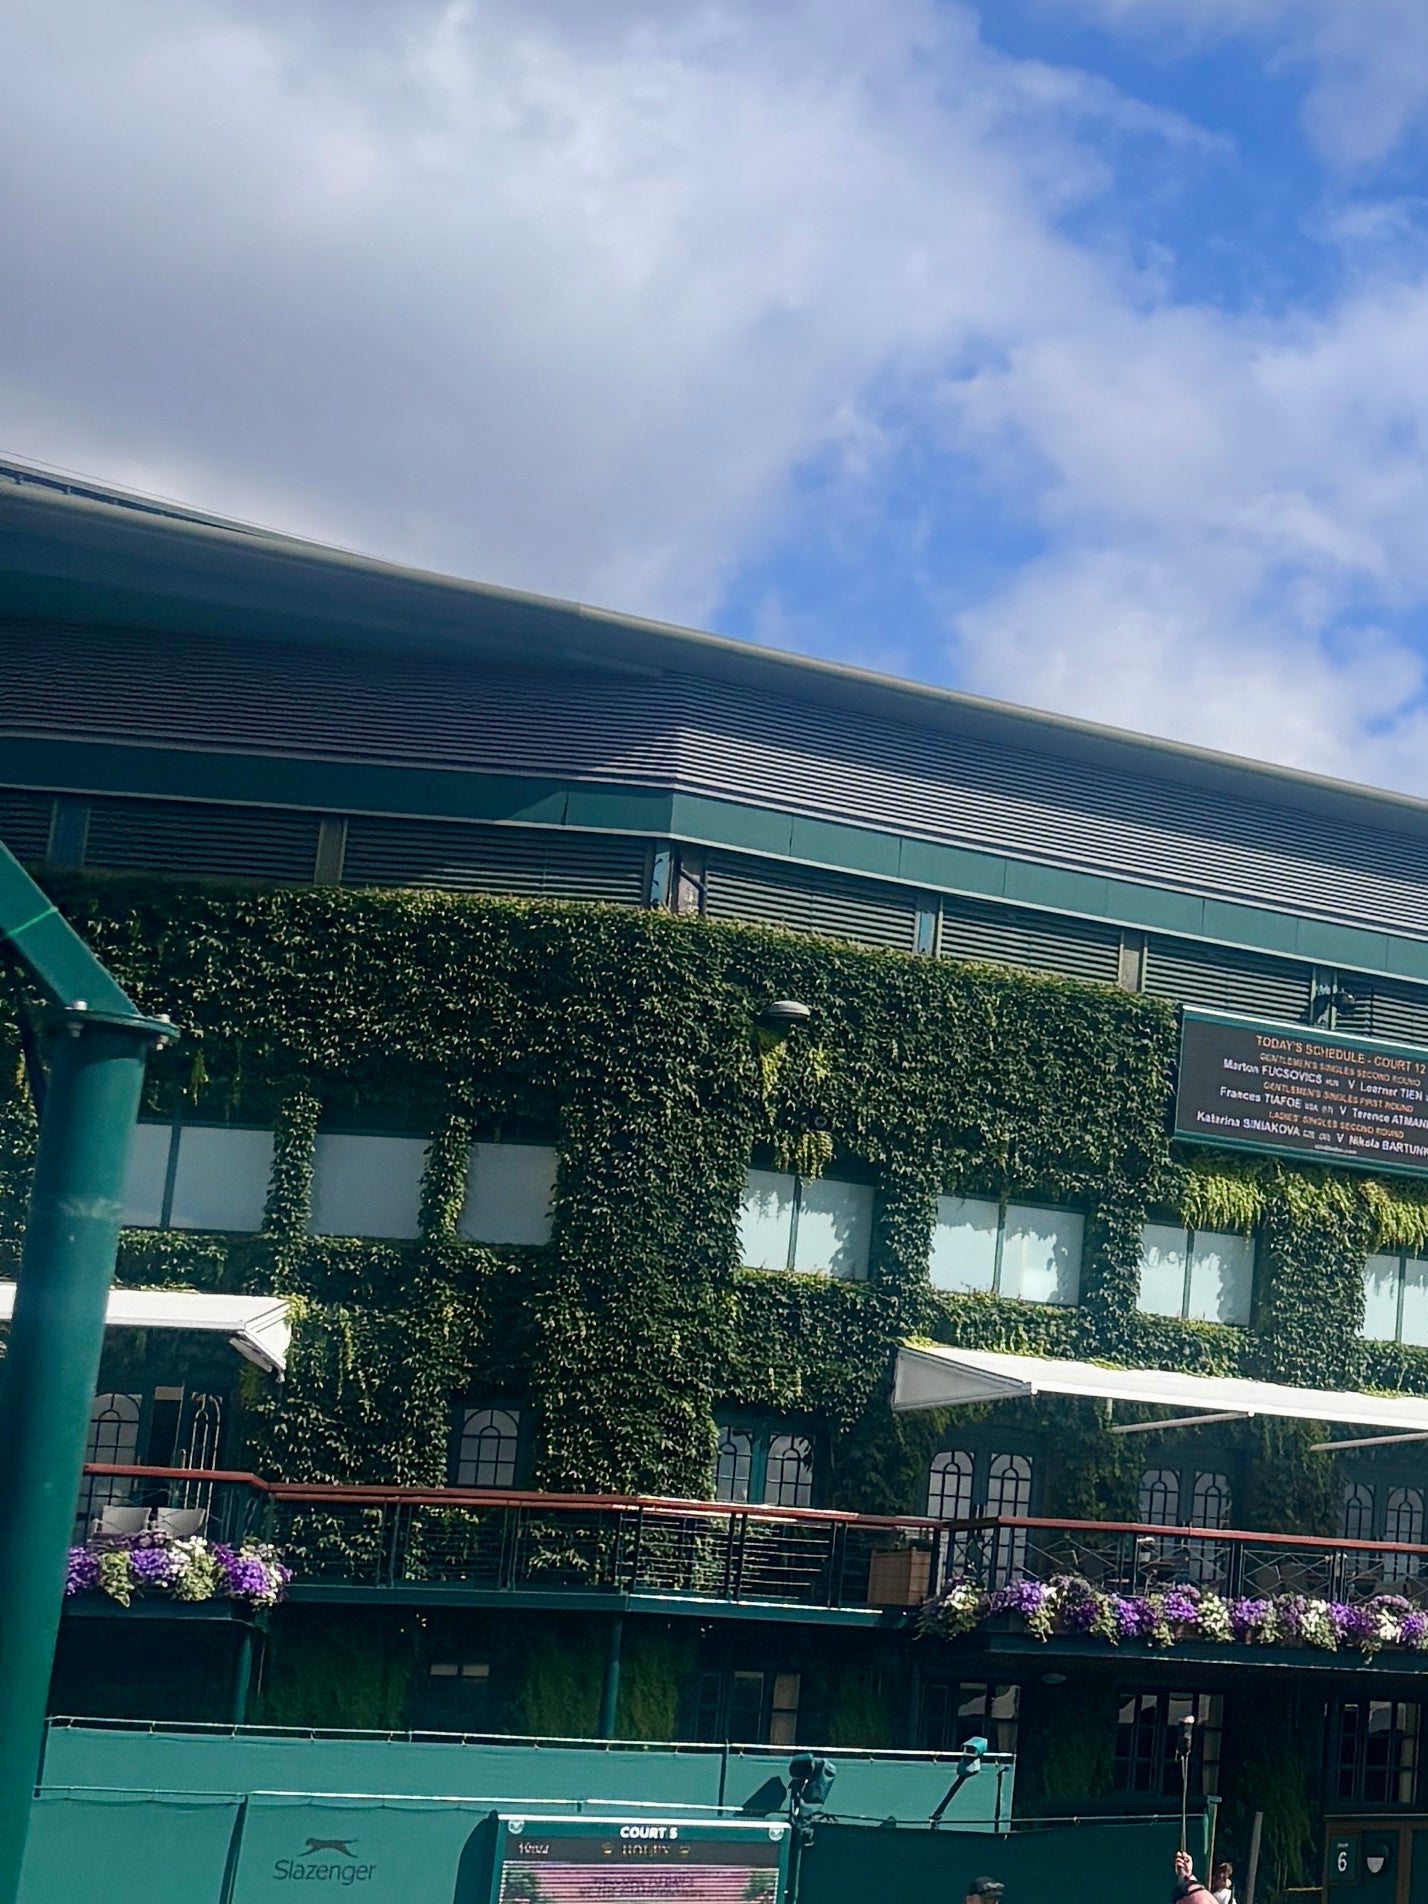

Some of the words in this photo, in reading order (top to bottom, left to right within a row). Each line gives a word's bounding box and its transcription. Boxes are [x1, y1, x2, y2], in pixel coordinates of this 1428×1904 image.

[1256, 1035, 1303, 1053] TODAY'S
[1305, 1043, 1365, 1064] SCHEDULE
[1374, 1056, 1411, 1072] COURT
[1414, 1063, 1426, 1074] 12
[1261, 1065, 1323, 1085] FUCSOVICS
[1348, 1079, 1356, 1090] V
[1360, 1082, 1399, 1097] Learner
[1400, 1088, 1423, 1103] TIEN
[1356, 1069, 1390, 1082] SECOND
[1392, 1074, 1421, 1087] ROUND
[1220, 1086, 1261, 1103] Frances
[1264, 1092, 1302, 1109] TIAFOE
[1339, 1106, 1347, 1116] V
[1352, 1107, 1390, 1123] Terence
[1360, 1098, 1383, 1109] FIRST
[1384, 1101, 1414, 1113] ROUND
[1196, 1110, 1241, 1128] Katerina
[1243, 1117, 1301, 1137] SINIAKOVA
[1336, 1132, 1345, 1143] V
[1348, 1134, 1381, 1149] Nikola
[1339, 1121, 1374, 1135] SECOND
[1375, 1127, 1405, 1139] ROUND
[620, 1825, 667, 1839] COURT
[669, 1827, 678, 1839] 5
[273, 1859, 376, 1886] Slazenger
[1337, 1851, 1347, 1872] 6
